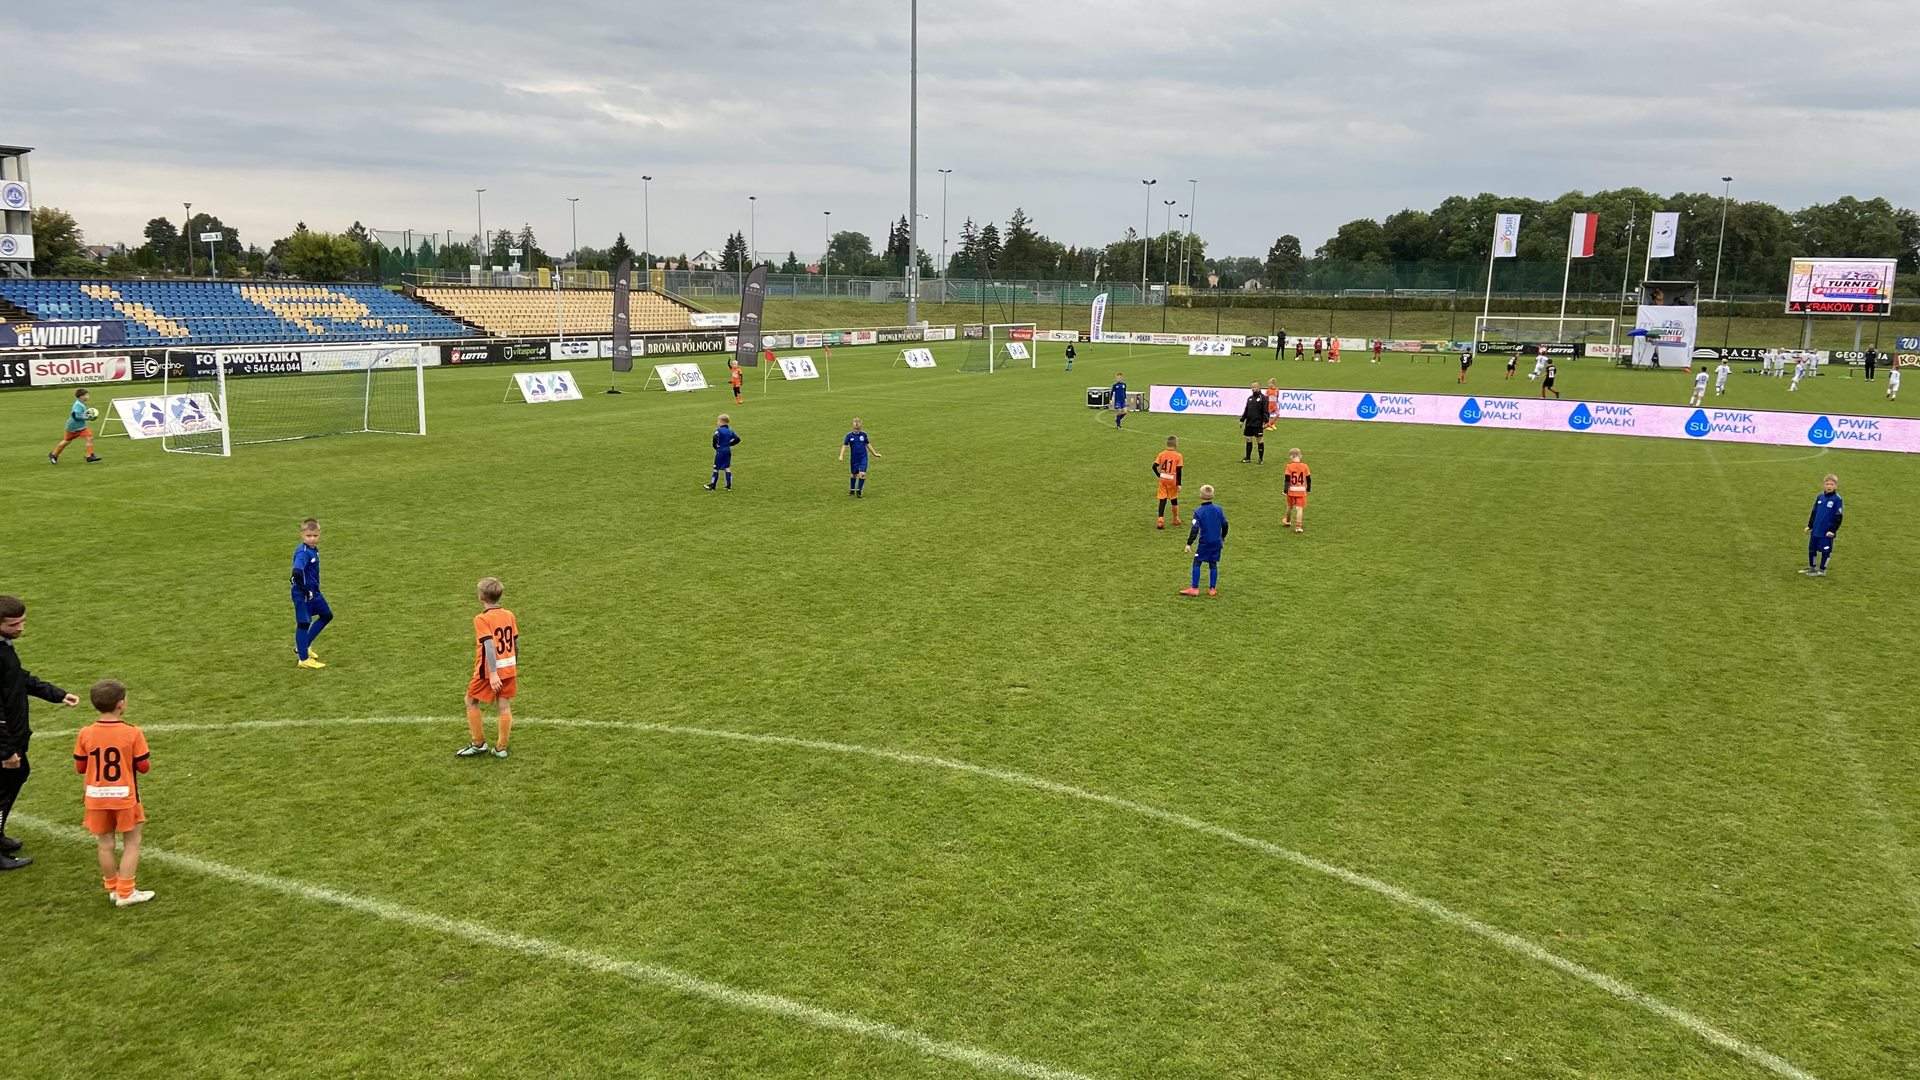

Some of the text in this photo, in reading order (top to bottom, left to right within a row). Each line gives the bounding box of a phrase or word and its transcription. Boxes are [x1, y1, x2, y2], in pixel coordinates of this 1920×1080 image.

[18, 325, 101, 346] ewinner
[512, 347, 547, 355] vitasport.pl
[648, 343, 681, 354] BROWAR
[682, 340, 723, 353] PÓŁNOCNY
[1592, 345, 1627, 354] stolar
[461, 352, 488, 360] LOTTO
[1721, 349, 1764, 357] RACIS
[36, 360, 104, 376] stollar
[254, 362, 300, 373] 544 544 044
[682, 373, 702, 383] OSIR
[1190, 389, 1219, 398] PWiK
[1282, 392, 1313, 401] PWiK
[1173, 398, 1222, 407] SUWAŁKI
[1380, 396, 1413, 405] PWiK
[1484, 400, 1520, 410] PWiK
[1361, 405, 1415, 415] SUWAŁKI
[1464, 409, 1522, 421] SUWAŁKI
[1595, 405, 1633, 416] PWiK
[1573, 415, 1635, 428] SUWAŁKI
[1713, 412, 1753, 423] PWiK
[1690, 422, 1755, 434] SUWAŁKI
[1837, 419, 1880, 430] PWiK
[1813, 429, 1882, 442] SUWAŁKI
[1161, 459, 1173, 473] 41
[1291, 471, 1304, 485] 54
[494, 625, 513, 655] 39
[89, 747, 121, 782] 18
